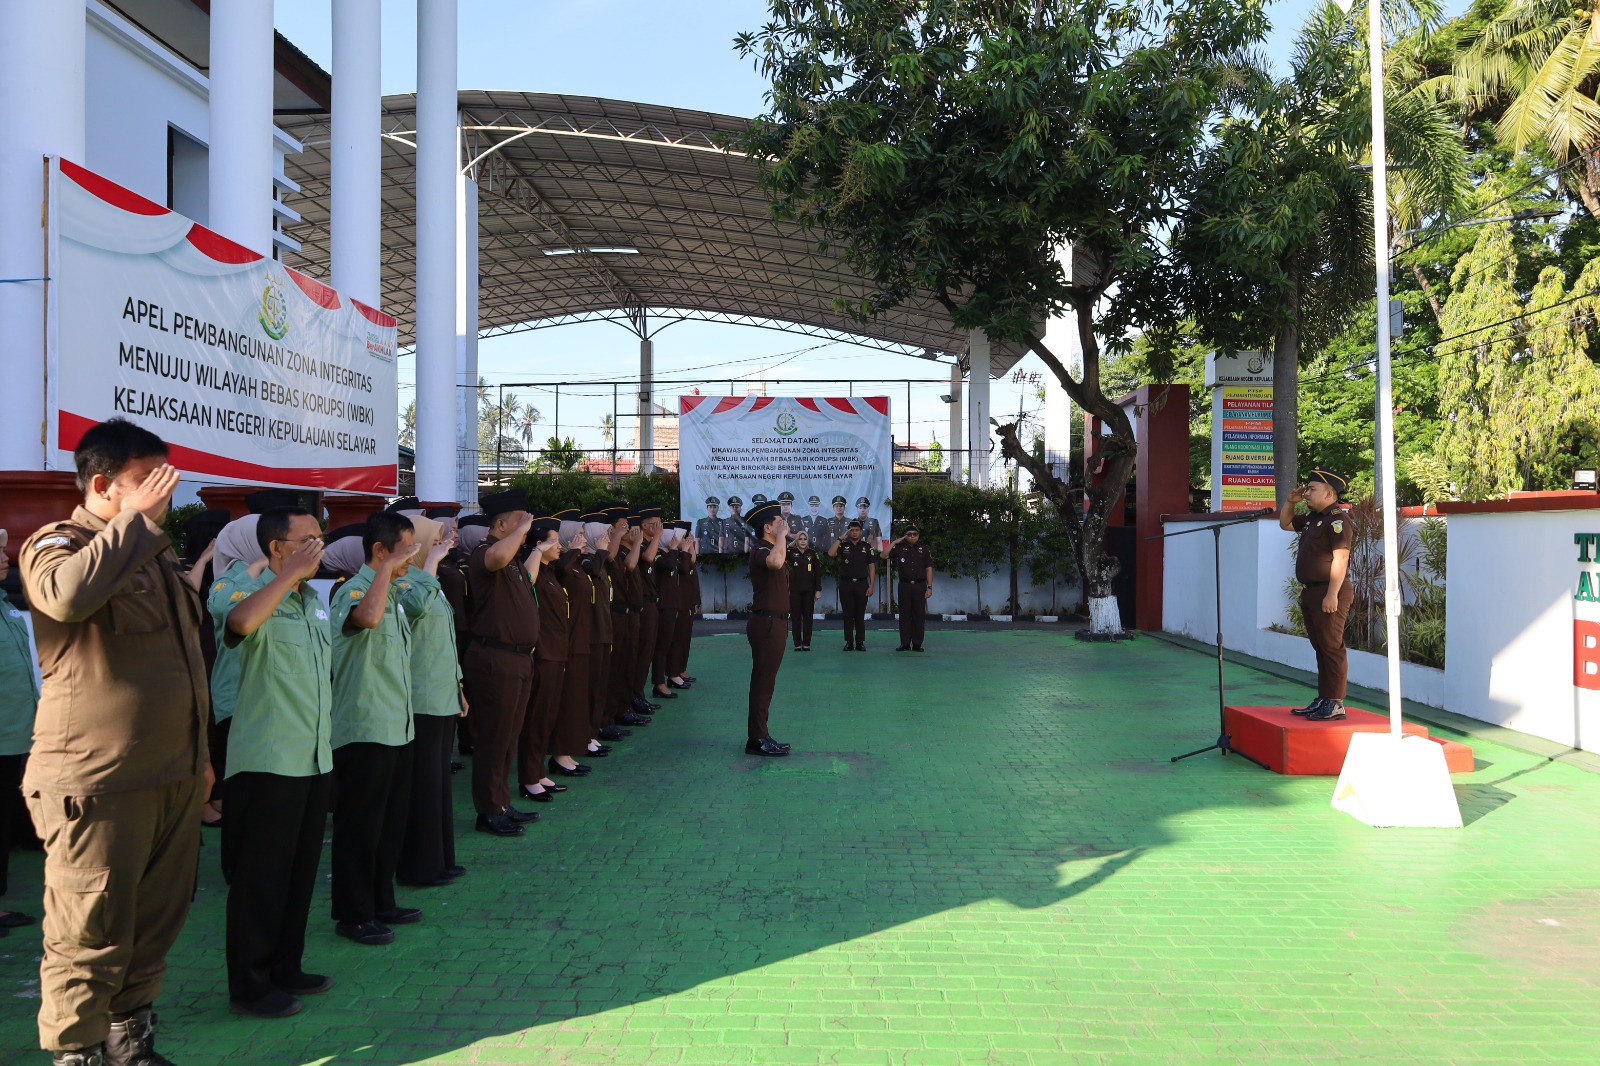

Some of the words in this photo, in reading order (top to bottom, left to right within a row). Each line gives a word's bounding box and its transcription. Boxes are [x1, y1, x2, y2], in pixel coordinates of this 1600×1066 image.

[119, 341, 191, 383] MENUJU
[195, 362, 258, 399] WILAYAH
[261, 380, 300, 409] BEBAS
[302, 391, 345, 419] KORUPSI
[347, 401, 374, 427] (WBK)
[122, 296, 169, 333] APEL
[173, 312, 284, 367] PEMBANGUNAN
[287, 349, 318, 378] ZONA
[320, 360, 373, 393] INTEGRITAS
[114, 385, 212, 428] KEJAKSAAN
[216, 407, 265, 438] NEGERI
[268, 418, 335, 449] KEPULAUAN
[336, 431, 377, 456] SELAYAR
